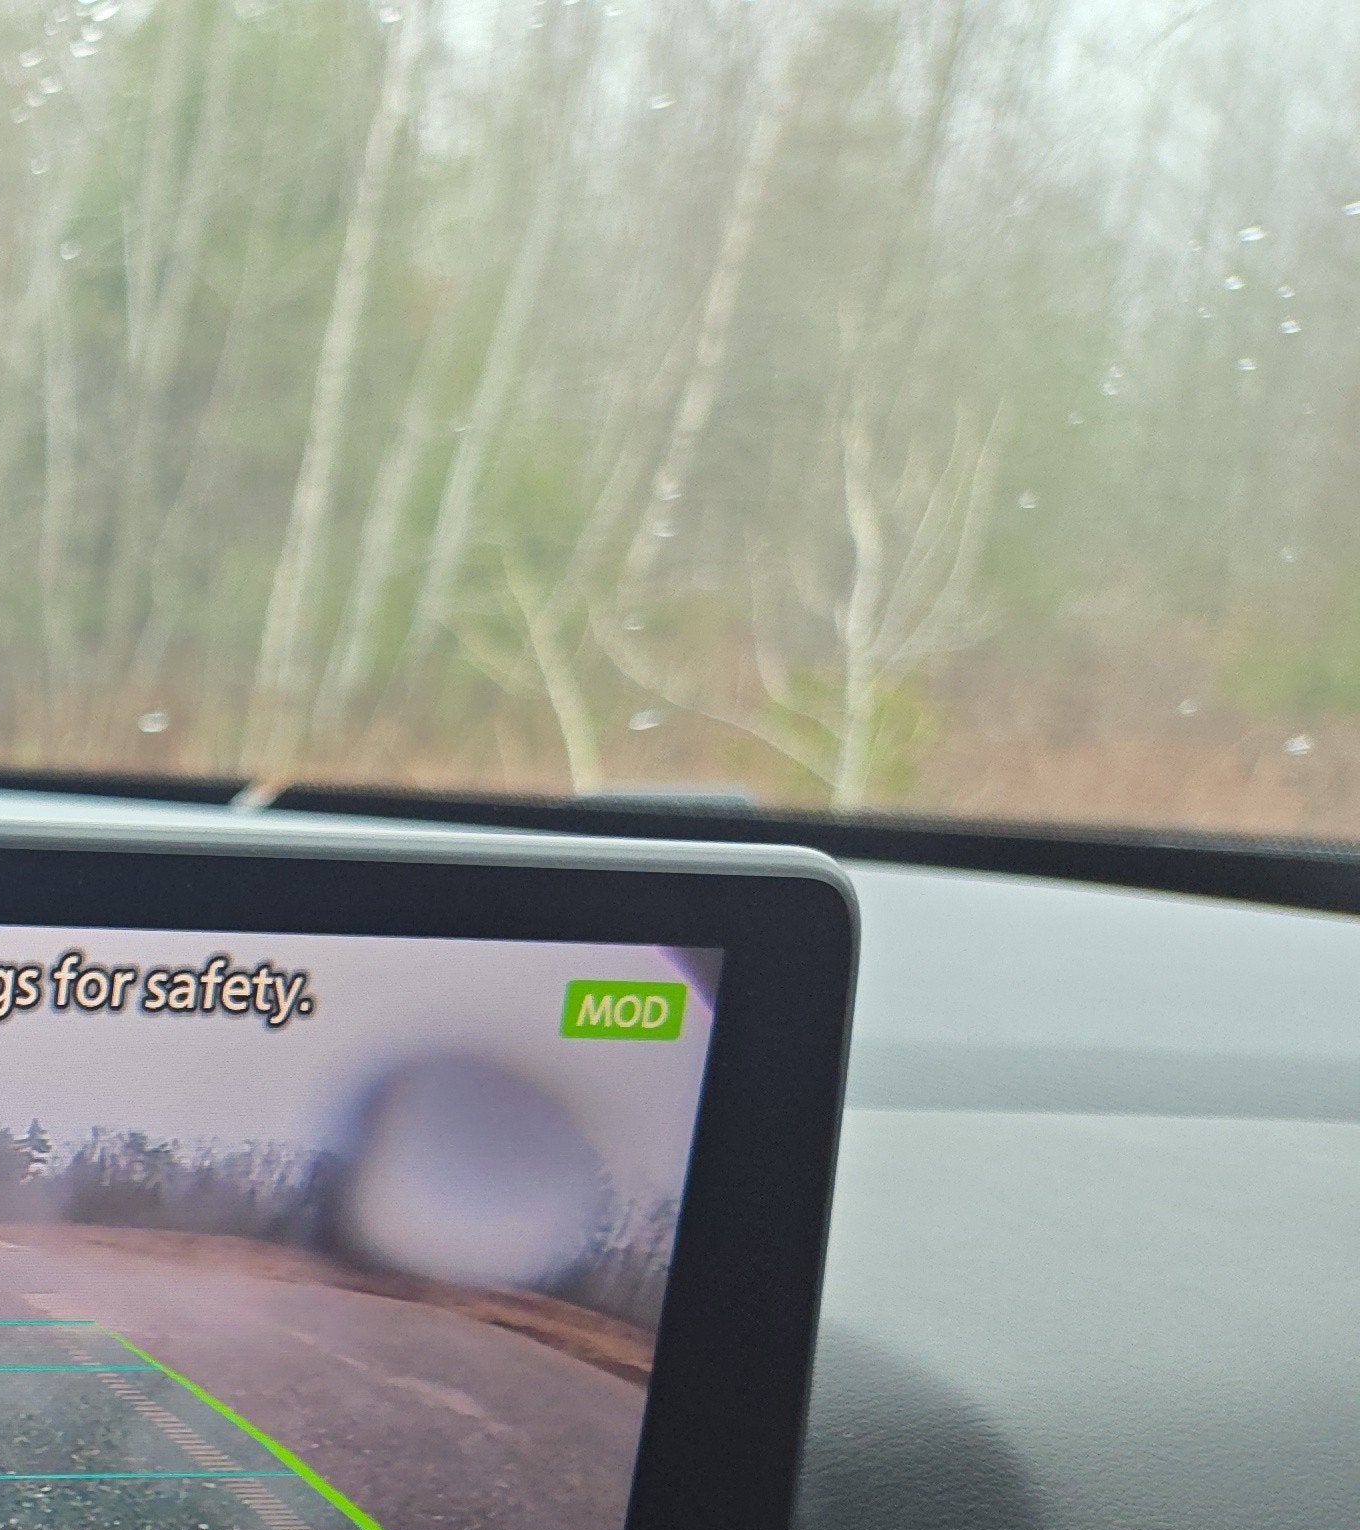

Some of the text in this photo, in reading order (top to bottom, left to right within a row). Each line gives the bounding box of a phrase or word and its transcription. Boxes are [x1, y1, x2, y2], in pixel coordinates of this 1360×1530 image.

[50, 951, 136, 1011] for
[144, 955, 314, 1028] safety.
[575, 993, 670, 1029] MOD
